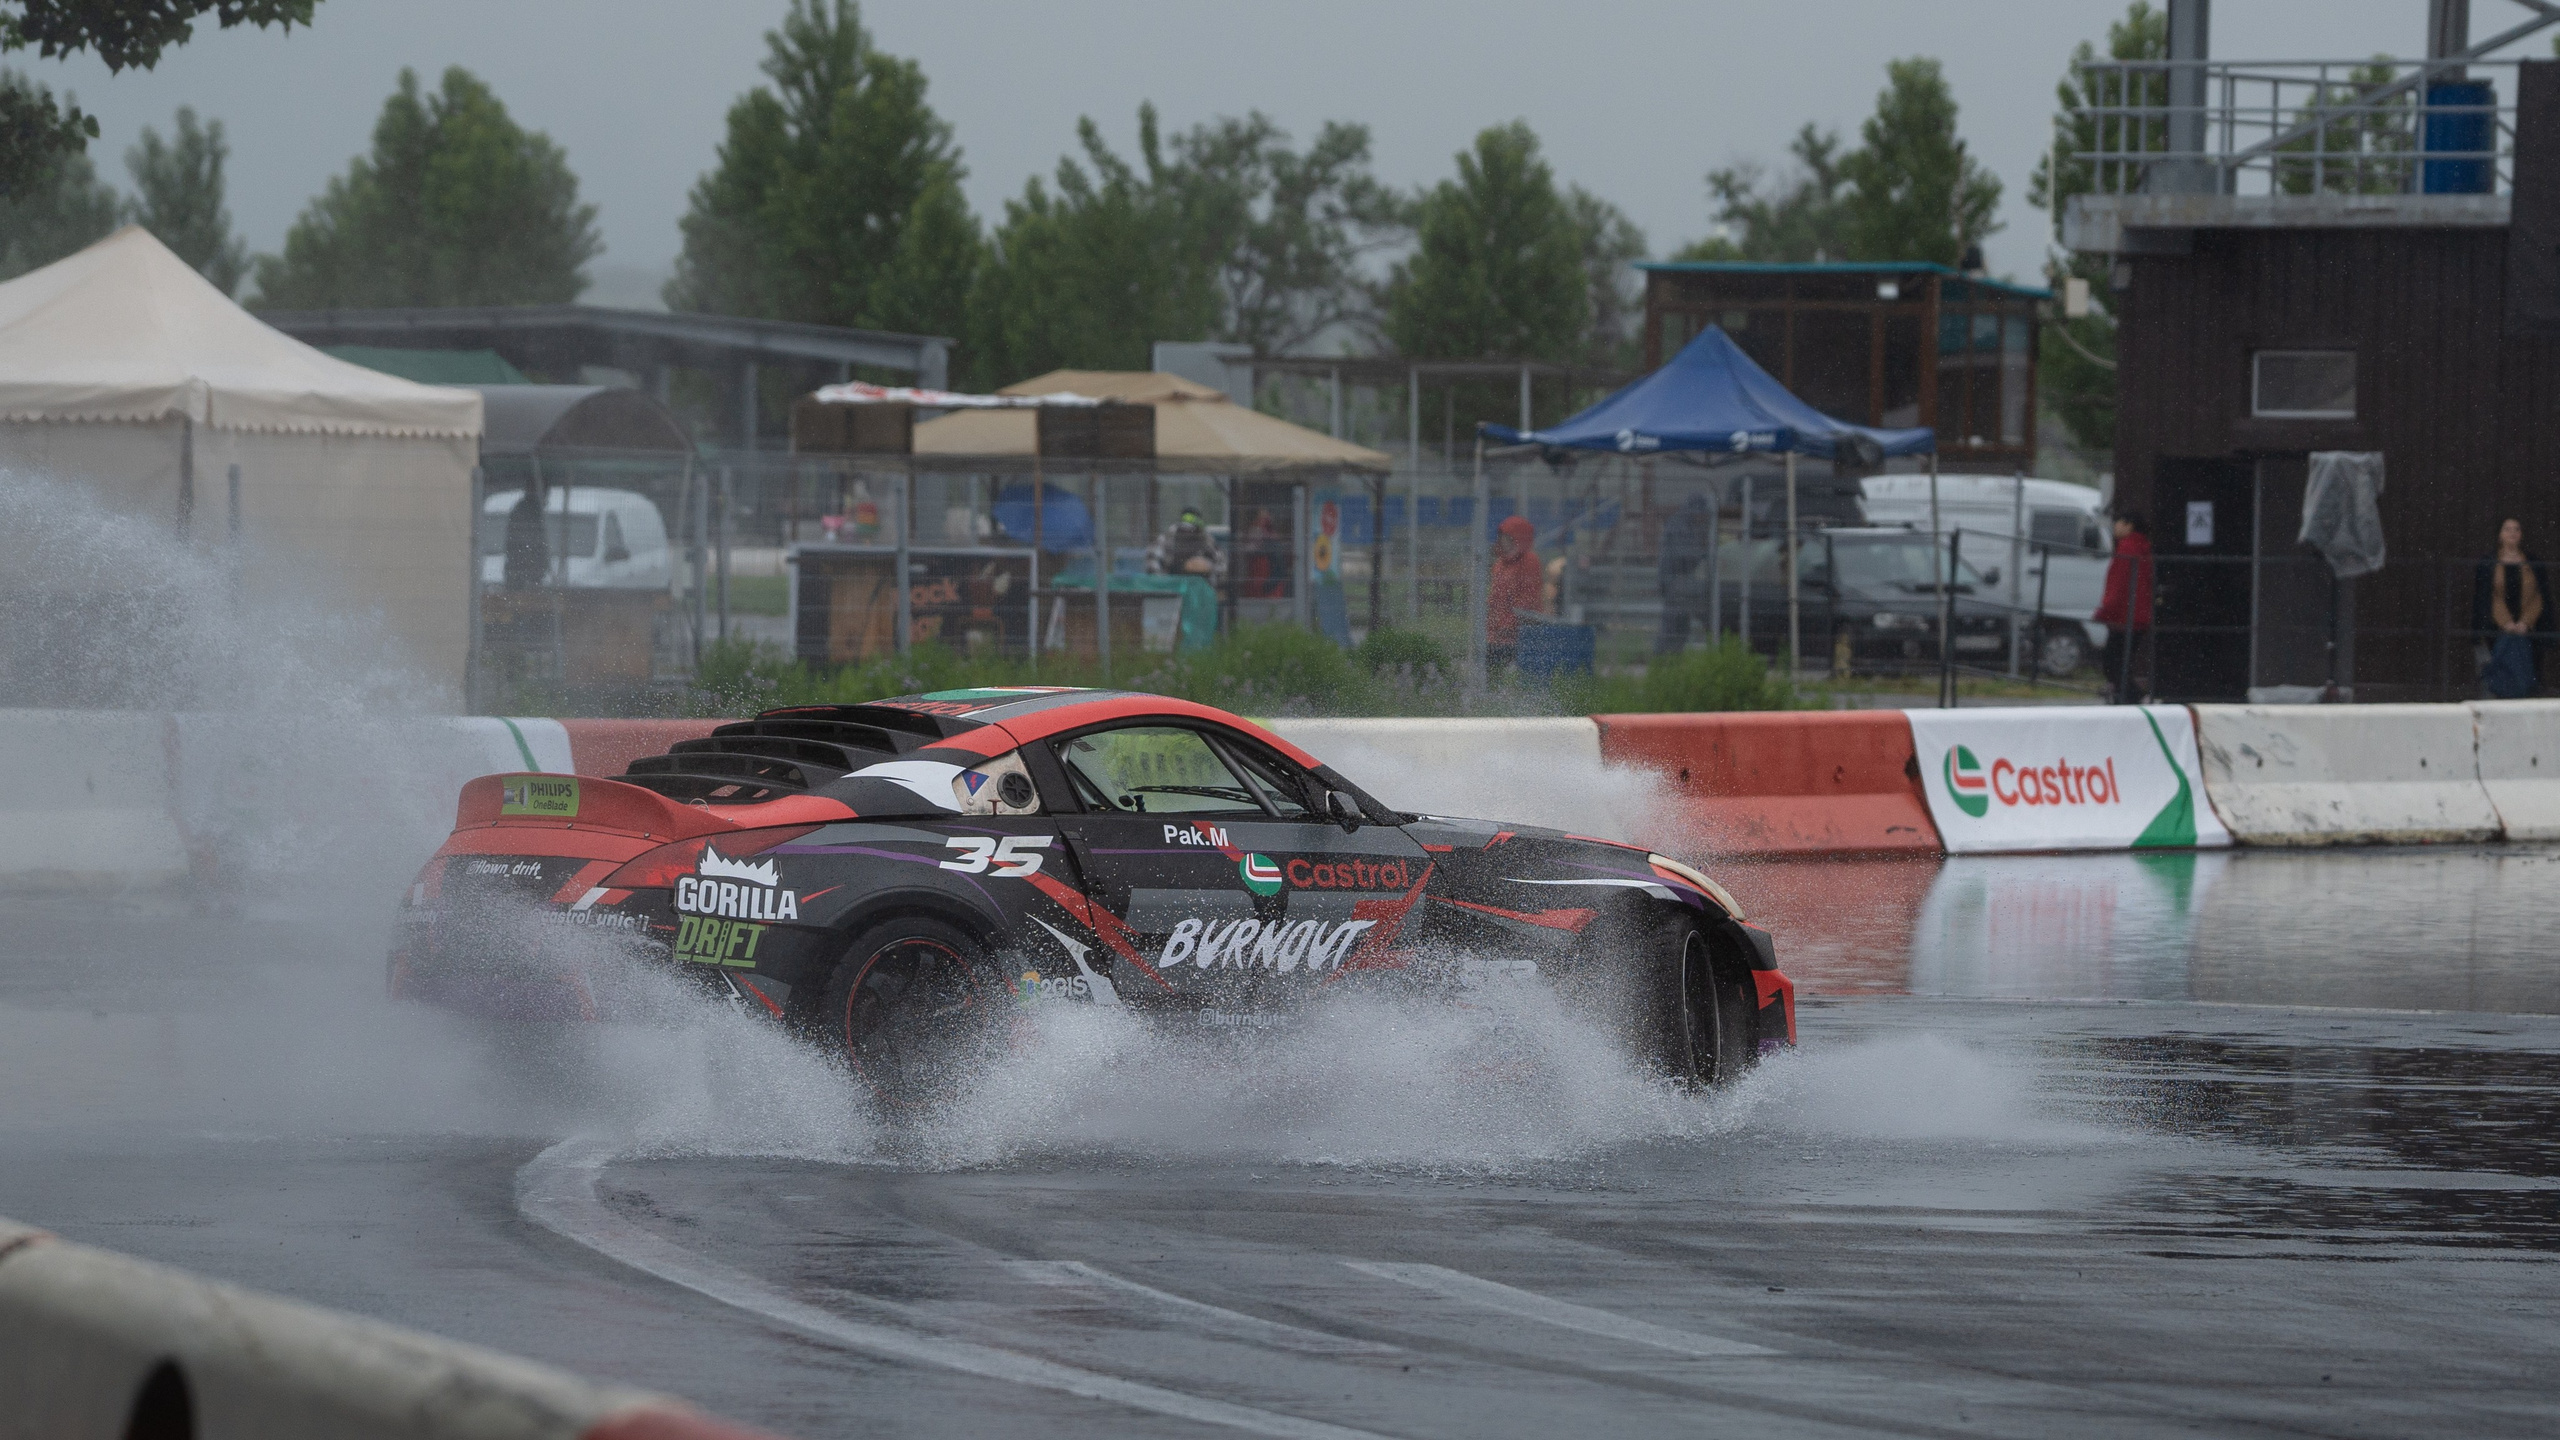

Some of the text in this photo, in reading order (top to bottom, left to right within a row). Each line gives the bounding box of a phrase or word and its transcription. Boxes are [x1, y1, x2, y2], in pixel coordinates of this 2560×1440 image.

[530, 782, 573, 798] PHILIPS
[1991, 756, 2121, 808] Castrol
[533, 799, 569, 812] OneBlade
[938, 835, 1054, 878] 35
[1163, 824, 1230, 848] Pak.M
[1287, 858, 1410, 889] Castrol
[678, 877, 798, 920] GORILLA
[675, 915, 767, 967] DRIFT
[1158, 917, 1377, 973] BURNOUT
